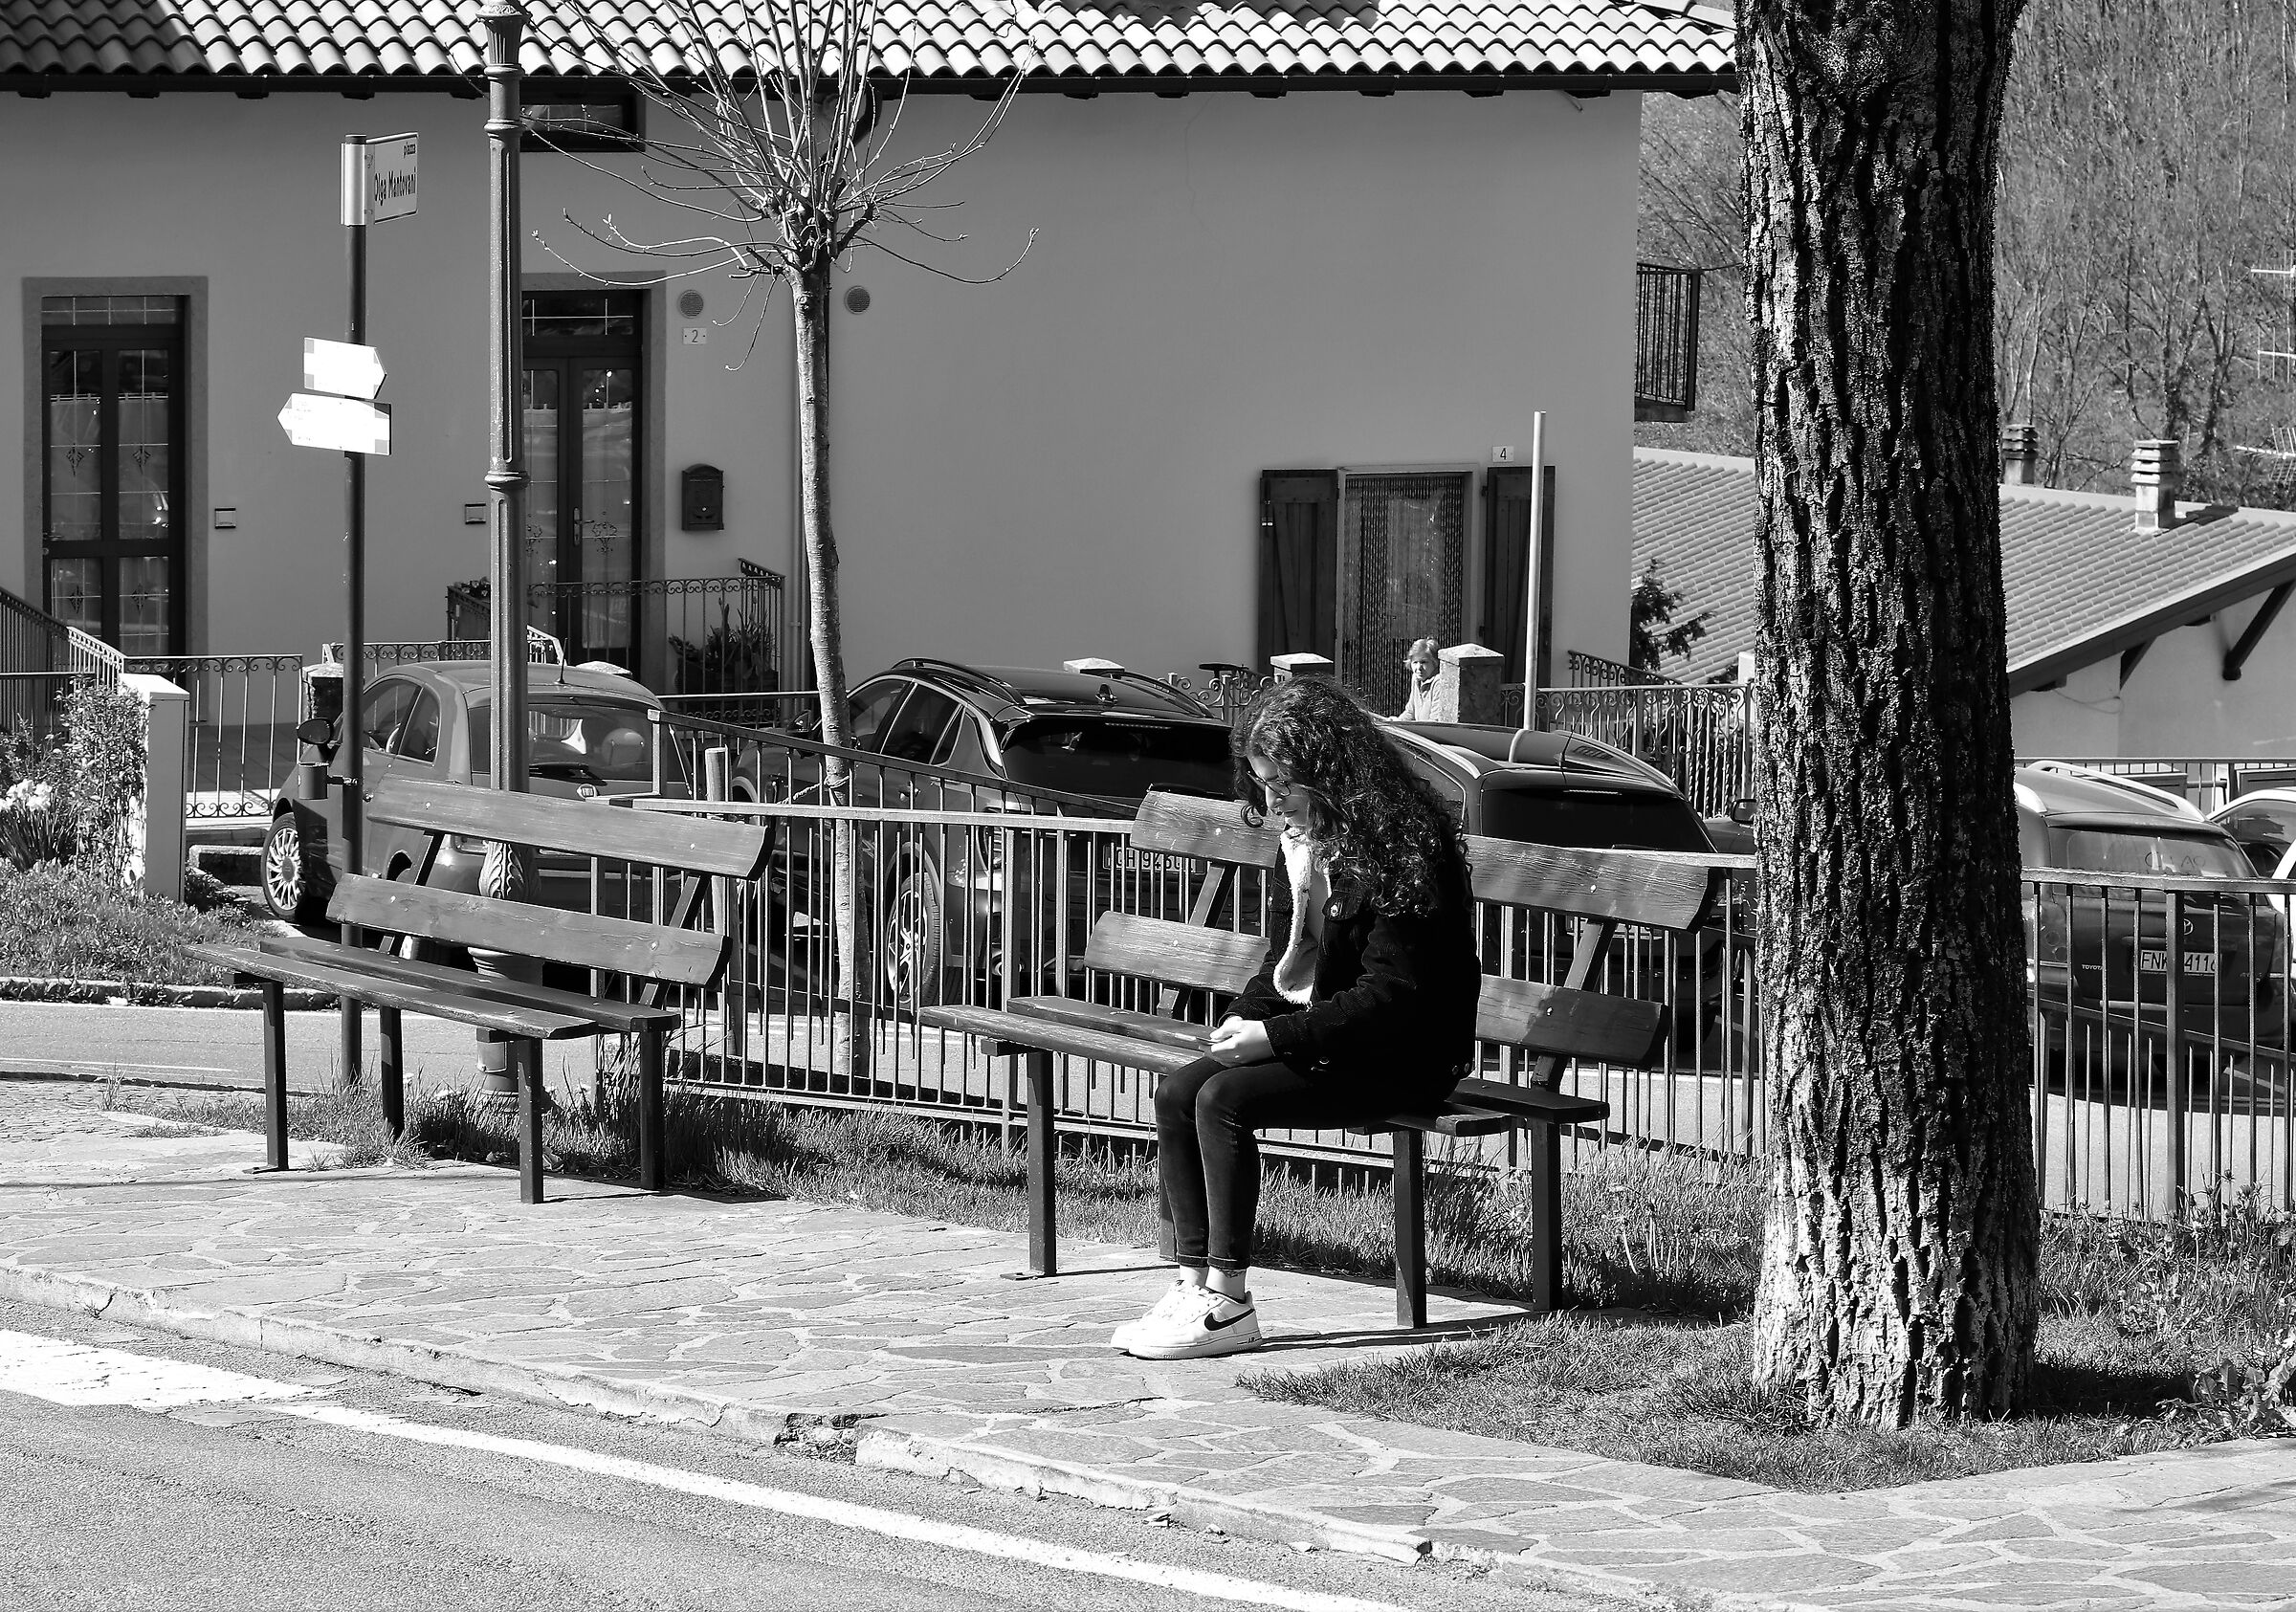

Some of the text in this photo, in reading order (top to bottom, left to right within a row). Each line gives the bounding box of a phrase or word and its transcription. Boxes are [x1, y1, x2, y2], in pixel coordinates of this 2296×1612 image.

[374, 166, 416, 207] Olga Mantovani
[692, 329, 698, 342] 2
[1500, 448, 1507, 460] 4
